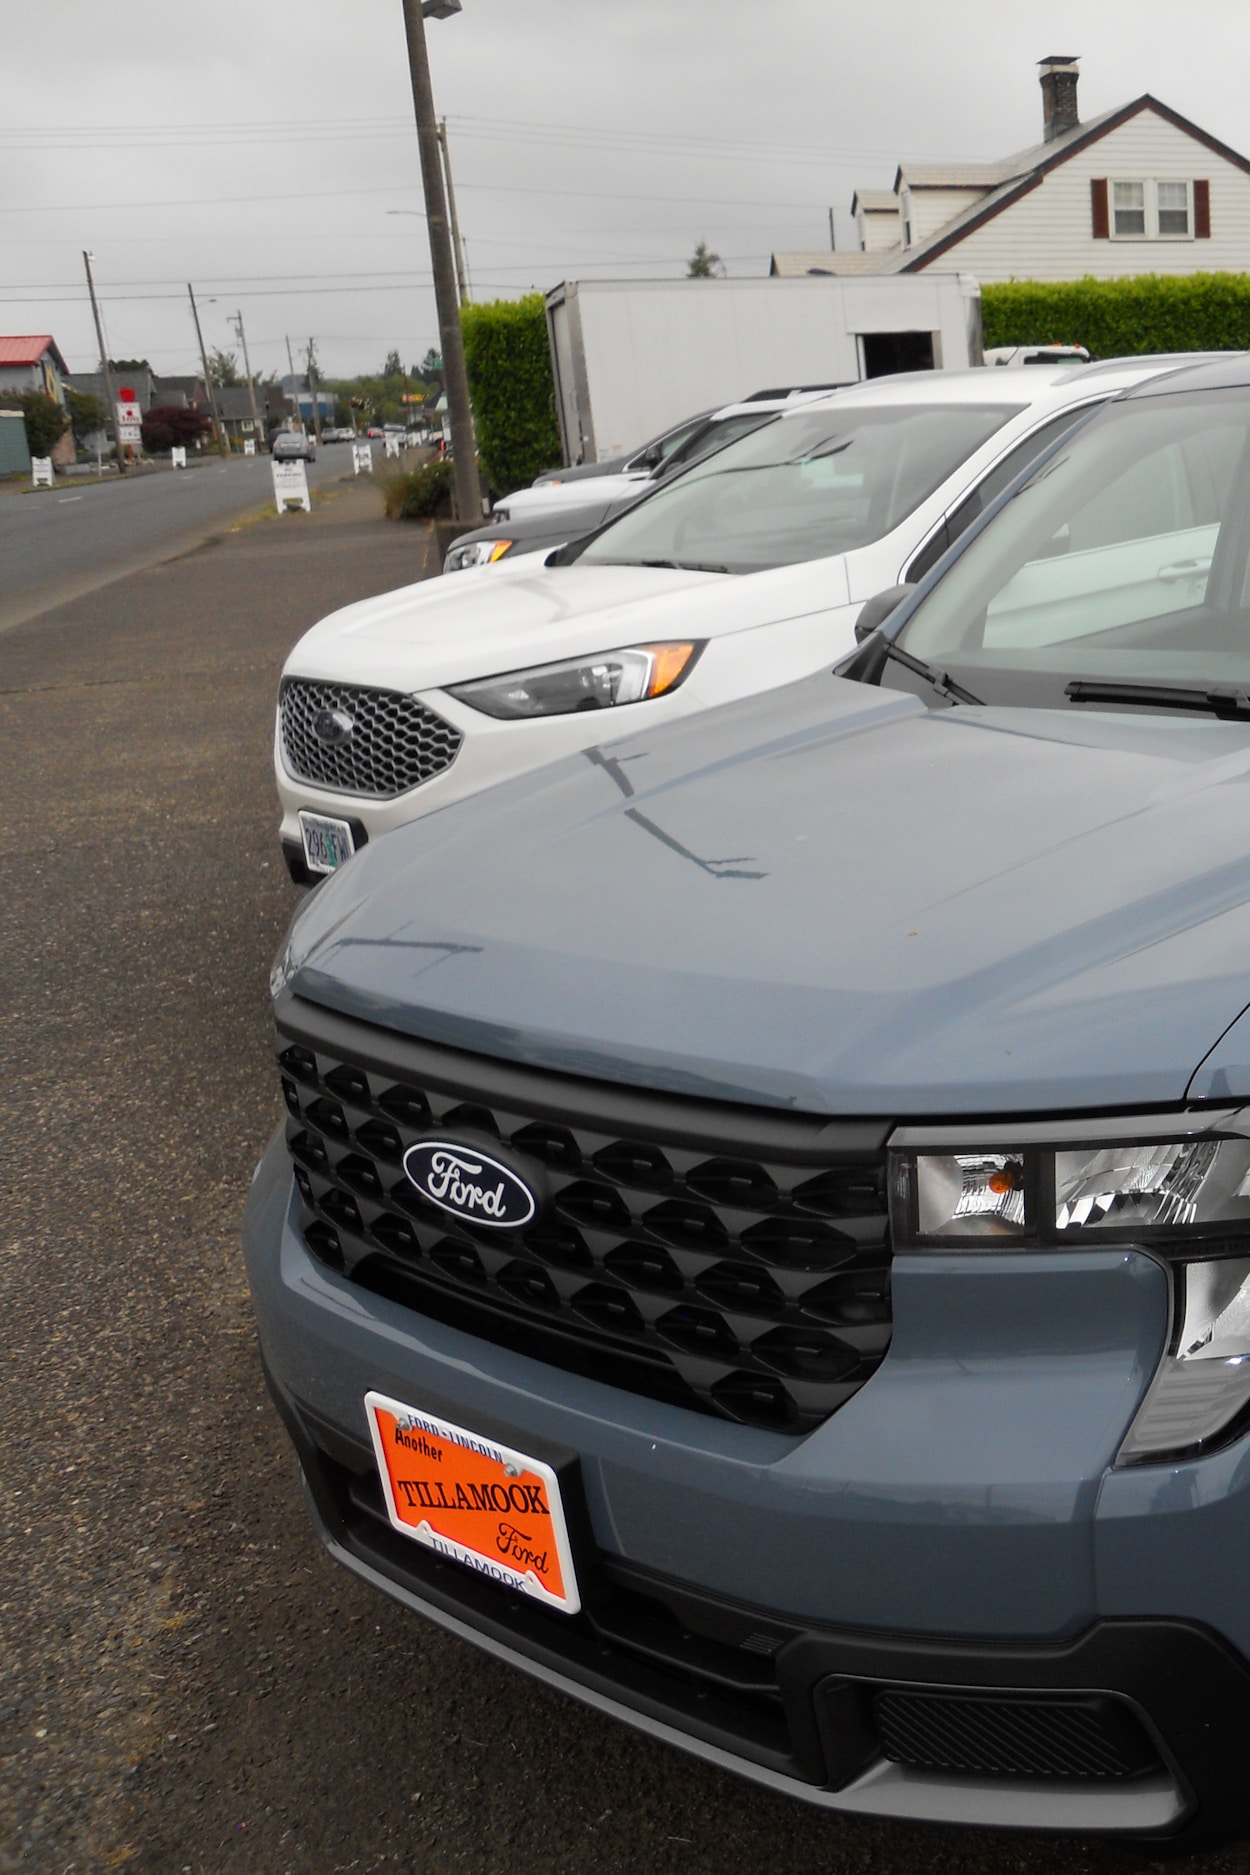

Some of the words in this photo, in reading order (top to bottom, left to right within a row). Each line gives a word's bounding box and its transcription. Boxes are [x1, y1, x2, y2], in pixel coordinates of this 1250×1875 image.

[305, 828, 328, 859] 296
[427, 1151, 507, 1218] Ford
[394, 1427, 443, 1463] Another
[407, 1414, 440, 1437] FORD
[448, 1430, 504, 1465] LINCOLN
[397, 1480, 550, 1515] TILLAMOOK
[429, 1535, 528, 1593] TILLAMOOK
[496, 1523, 549, 1574] Ford
